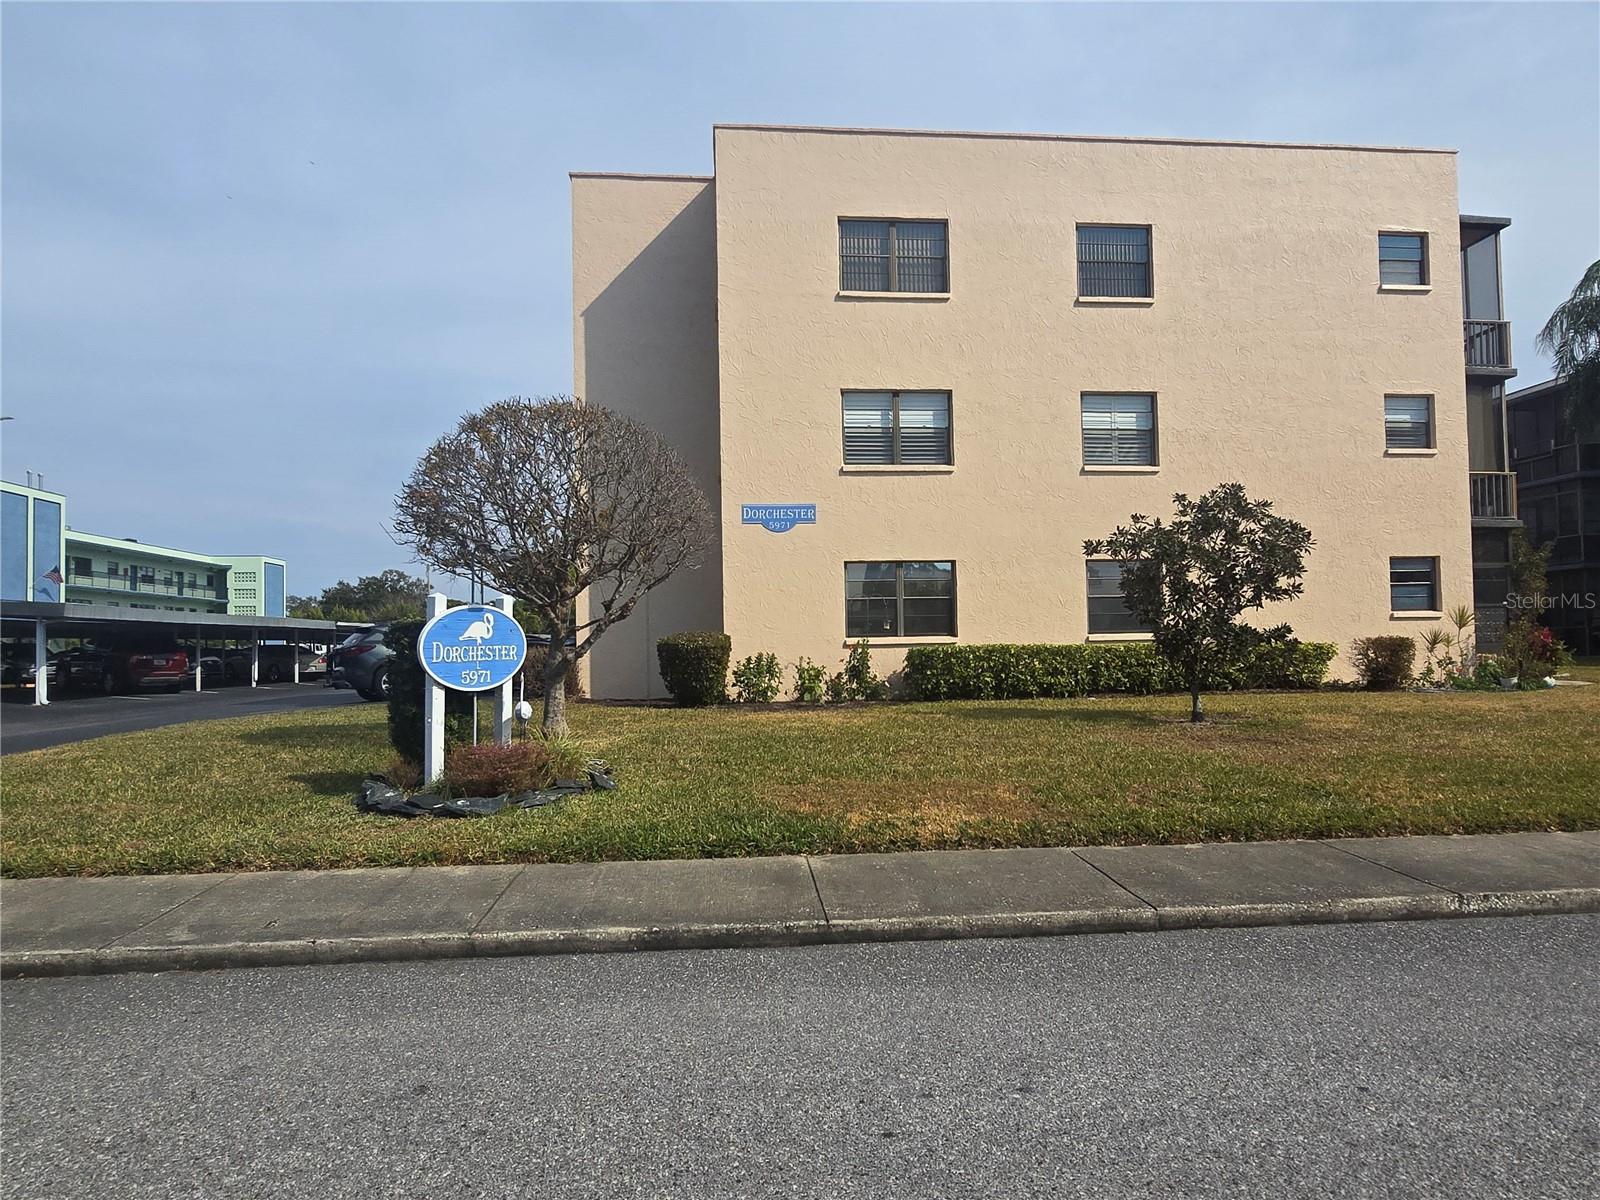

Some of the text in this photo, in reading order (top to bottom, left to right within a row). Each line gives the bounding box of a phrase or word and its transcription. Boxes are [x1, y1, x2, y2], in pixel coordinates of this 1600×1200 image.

[743, 507, 815, 519] DORCHESTER
[769, 521, 790, 530] 5971
[432, 641, 518, 663] DORCHESTER
[461, 670, 491, 685] 5971
